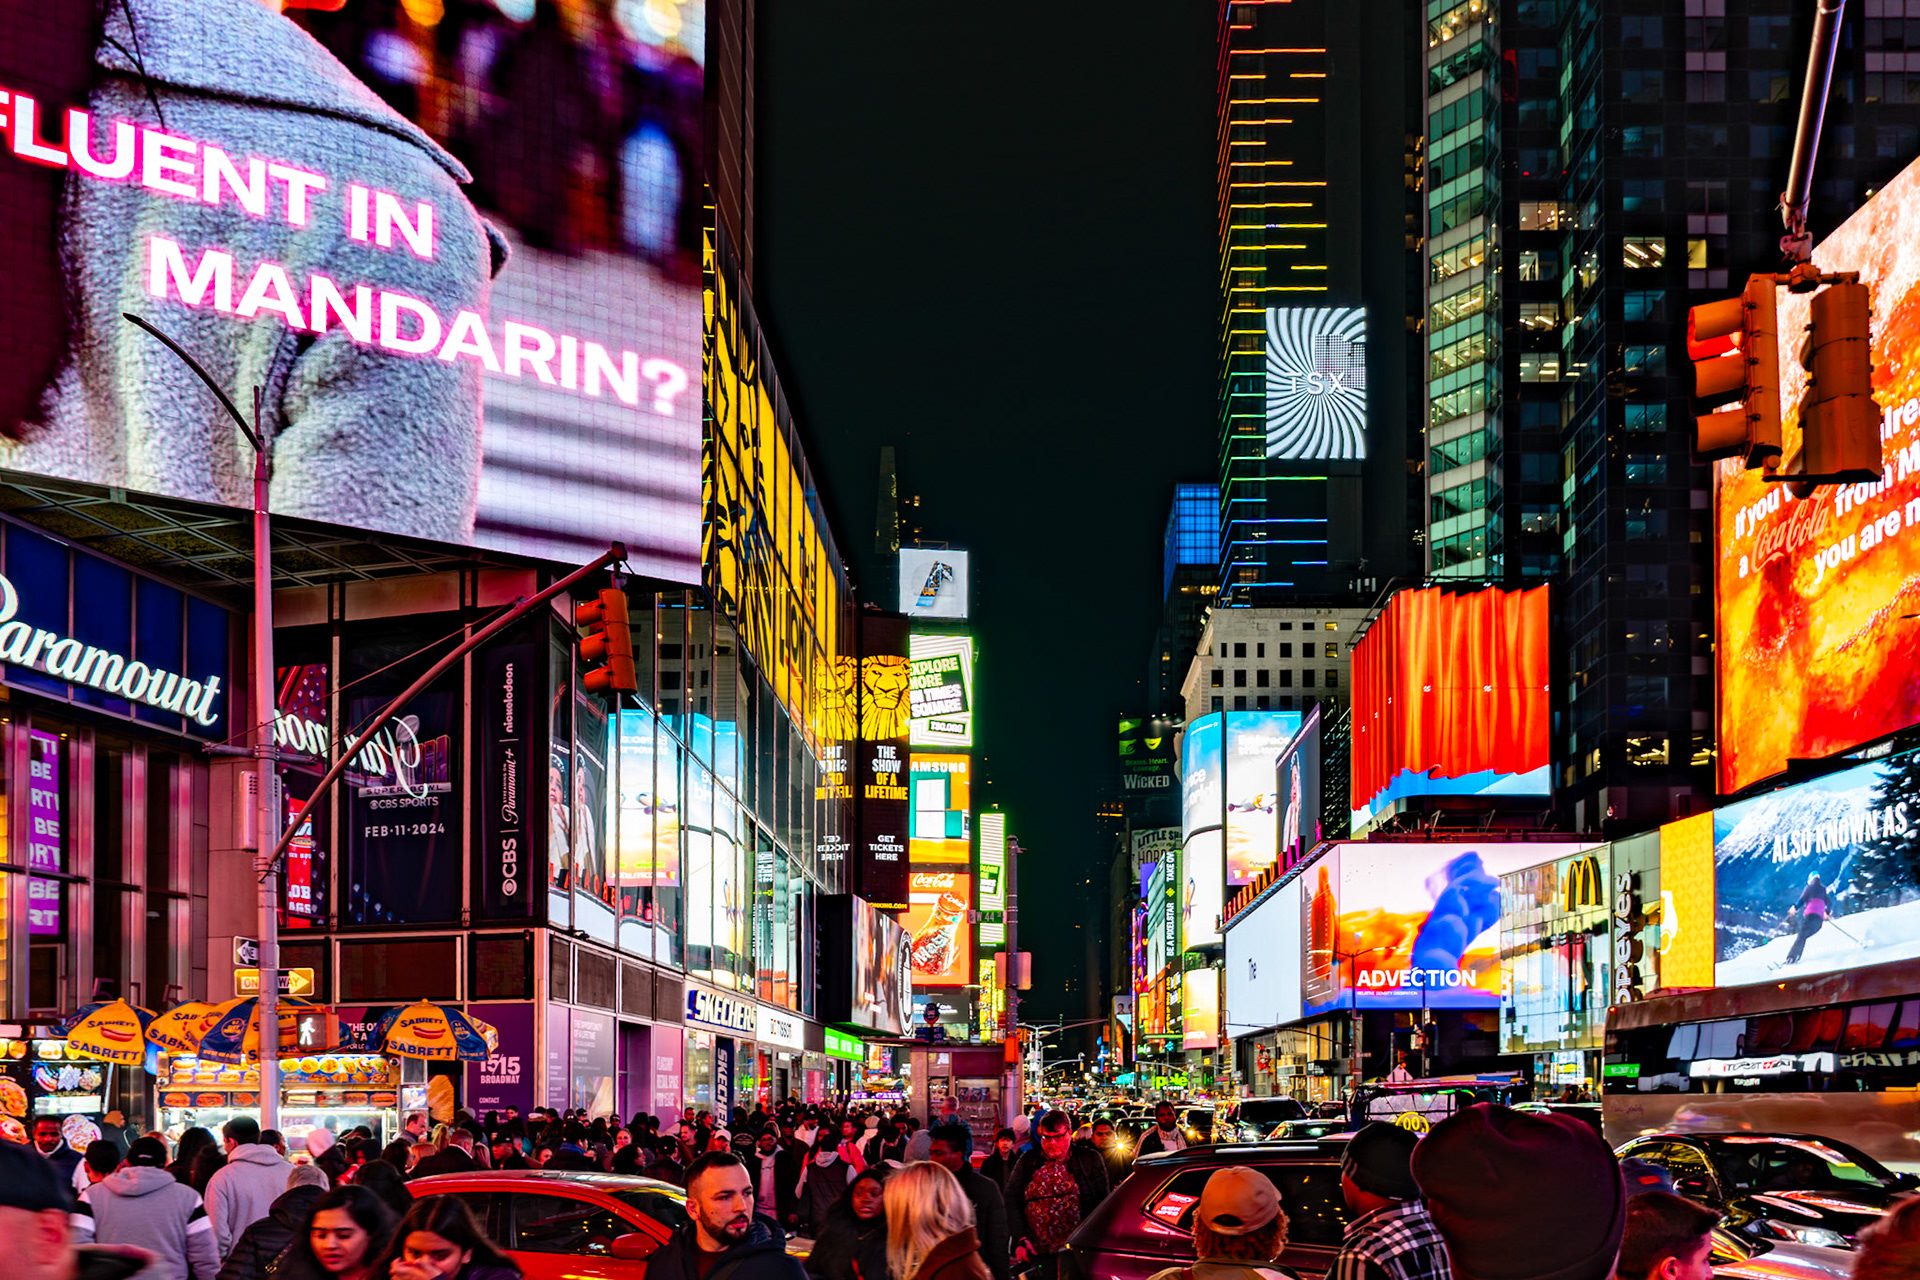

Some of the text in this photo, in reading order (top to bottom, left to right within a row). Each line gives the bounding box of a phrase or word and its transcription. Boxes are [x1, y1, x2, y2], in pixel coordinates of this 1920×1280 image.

[0, 92, 435, 259] LUENT IN
[149, 235, 689, 416] MANDARIN?
[1286, 372, 1346, 394] TSX
[1735, 505, 1745, 540] If
[1747, 487, 1780, 537] you
[1814, 533, 1856, 585] you
[1859, 509, 1901, 552] are
[1738, 555, 1749, 579] a
[911, 698, 962, 718] SQUARE
[876, 745, 896, 759] THE
[1867, 742, 1891, 758] PRIME
[871, 758, 902, 773] SHOW
[876, 772, 897, 786] OF A
[366, 786, 403, 796] SUPER
[864, 785, 909, 800] LIFETIME
[378, 797, 439, 809] CBS SPORTS
[877, 835, 895, 843] GET
[1137, 830, 1167, 848] LITTLE
[1772, 801, 1908, 863] ALSO KNOWN AS
[868, 843, 904, 852] TICKETS
[502, 838, 517, 878] CBS
[875, 852, 898, 861] HERE
[1166, 863, 1175, 882] TAKE
[984, 911, 995, 922] 44
[1166, 902, 1175, 936] PIXELSTAR
[1166, 943, 1175, 956] BE
[1357, 969, 1477, 987] ADVECTION
[401, 1017, 443, 1028] SABRETT
[69, 1039, 140, 1062] SABRETT
[389, 1040, 454, 1057] SABRETT
[480, 1075, 520, 1084] BROADWAY
[478, 1096, 500, 1104] CONTACT
